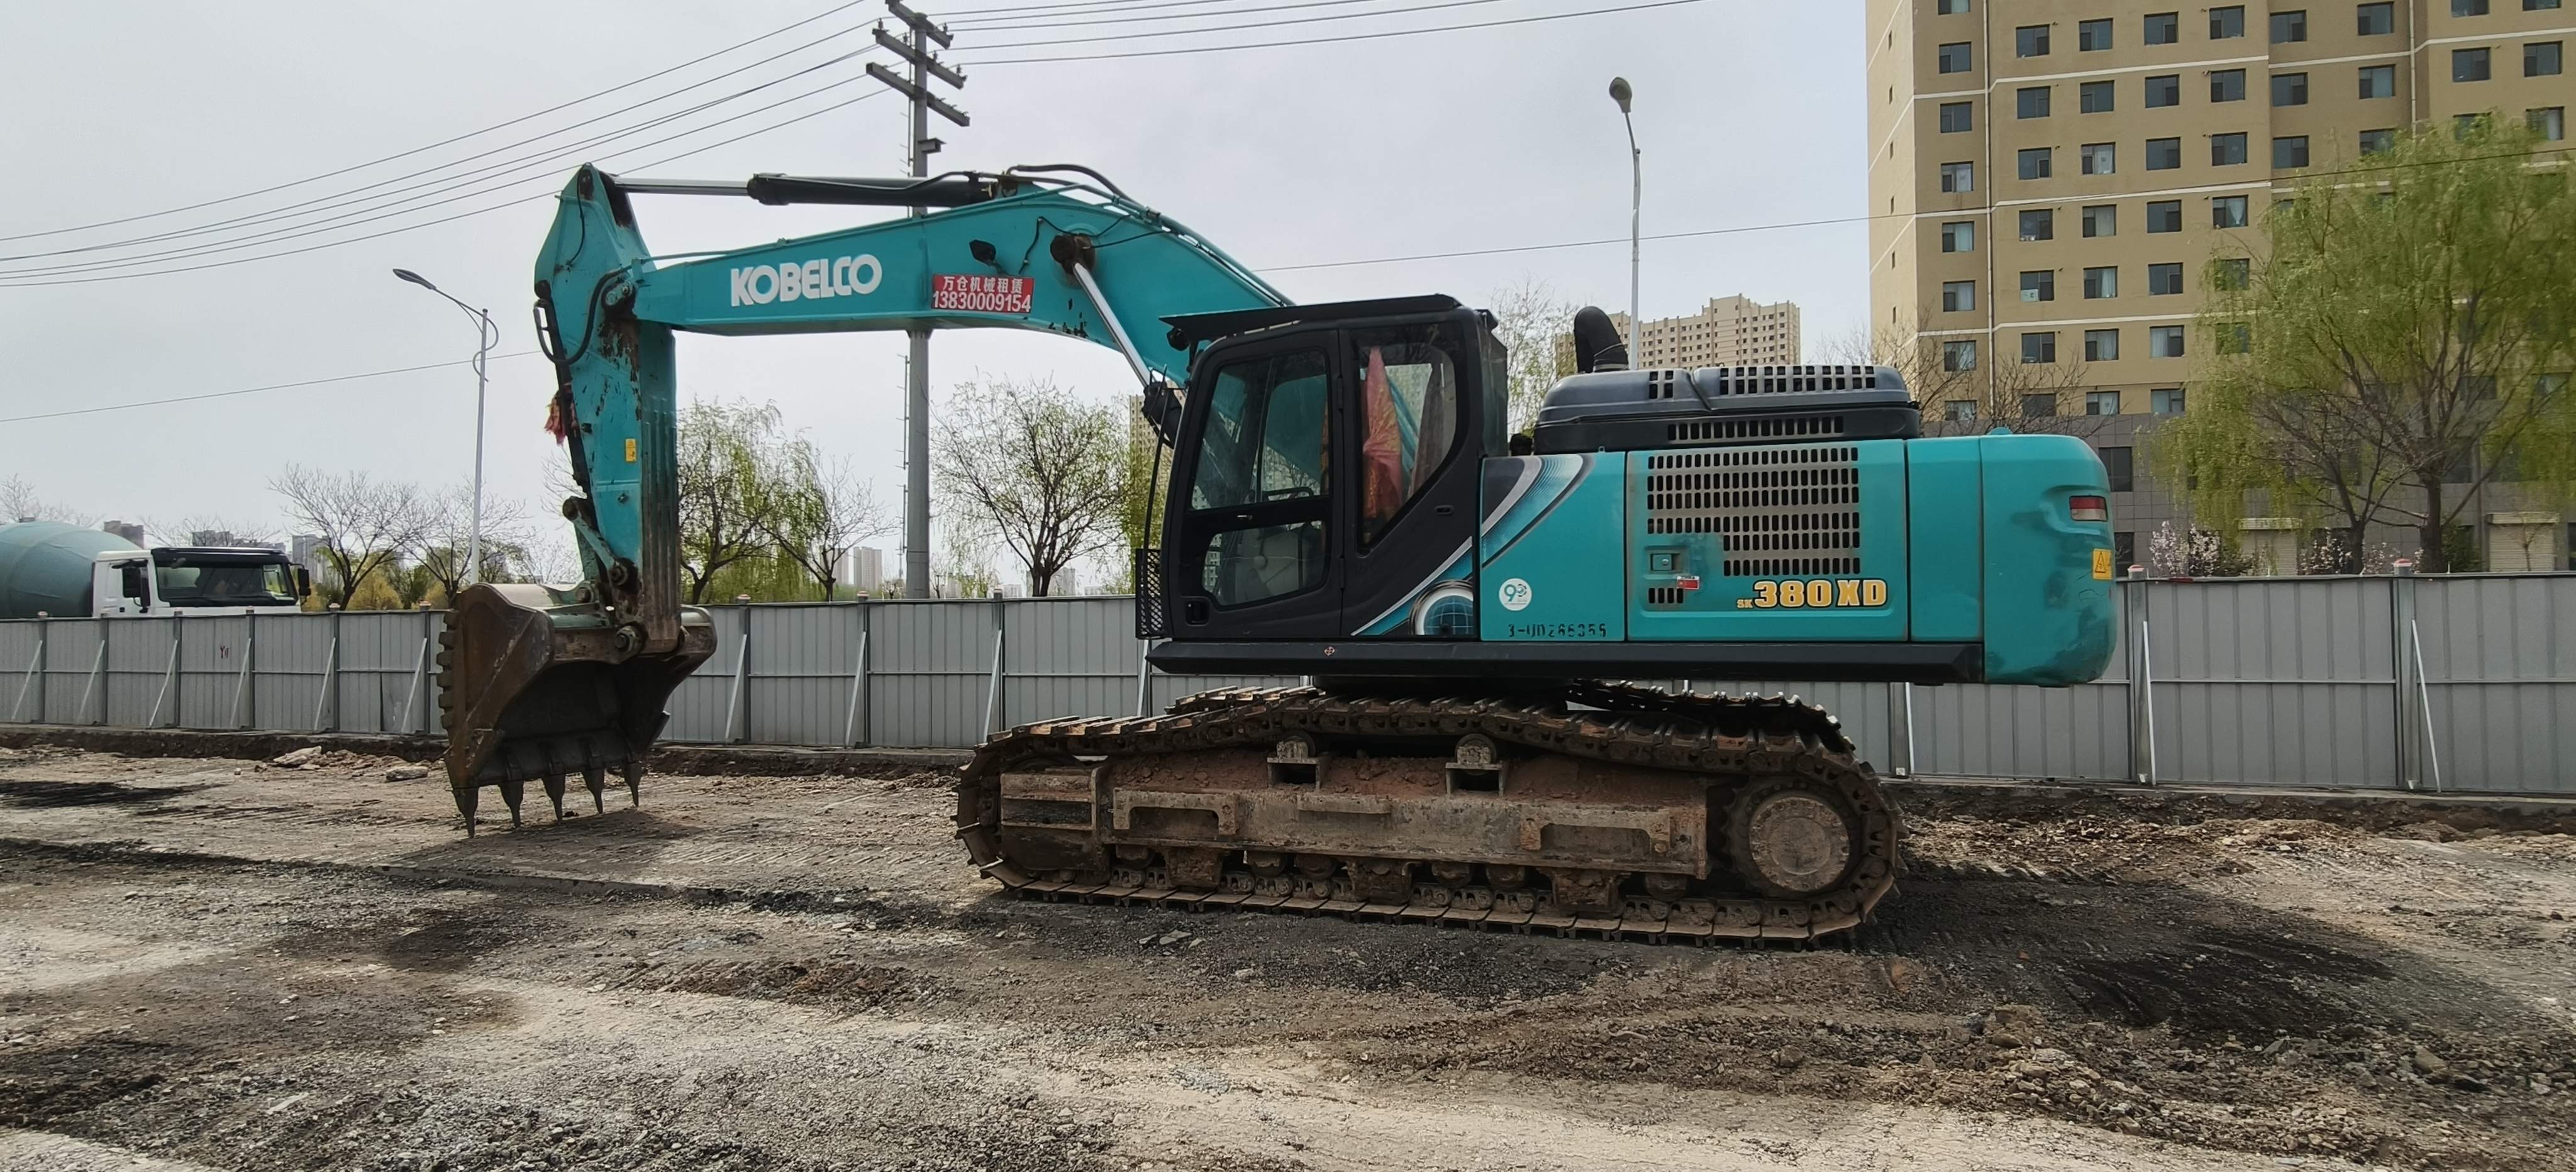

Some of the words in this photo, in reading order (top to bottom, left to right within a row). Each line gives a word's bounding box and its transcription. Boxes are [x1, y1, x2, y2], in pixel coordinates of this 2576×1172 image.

[731, 254, 882, 306] KOBELCO
[943, 275, 1023, 294] 万仓机械租赁
[933, 290, 1031, 312] 13830009154
